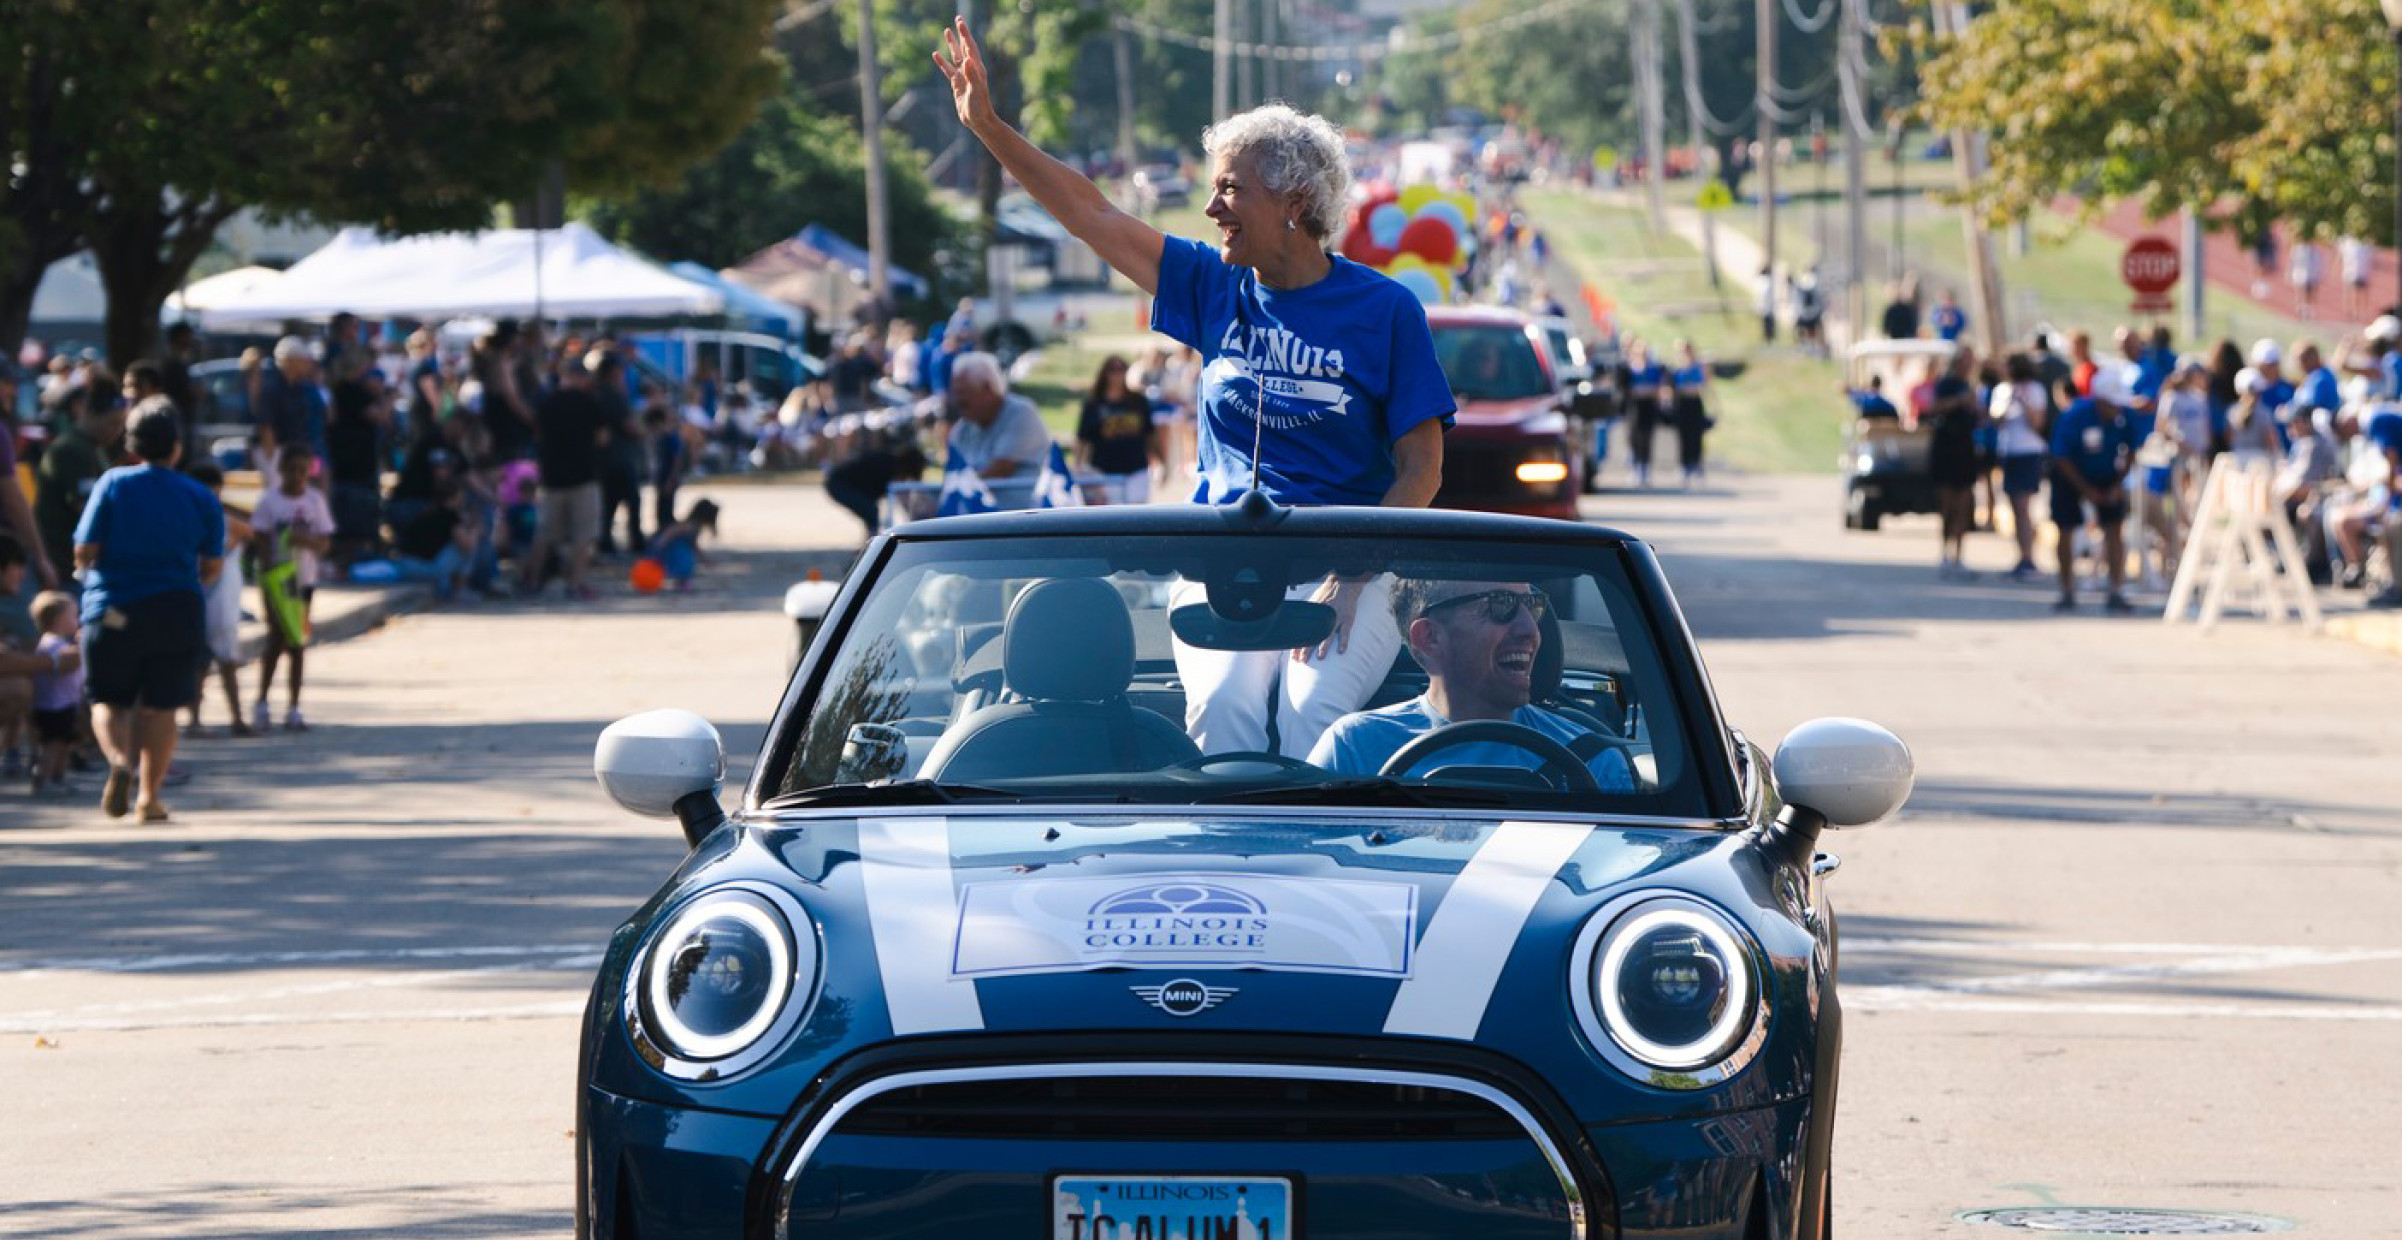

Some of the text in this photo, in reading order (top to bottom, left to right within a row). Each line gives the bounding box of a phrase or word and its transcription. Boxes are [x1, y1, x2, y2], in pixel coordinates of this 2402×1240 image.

[1086, 917, 1268, 930] ILLINOIS
[1085, 933, 1265, 947] COLLEGE
[1165, 991, 1202, 1002] MINI
[1118, 1185, 1229, 1199] ILLINOIS
